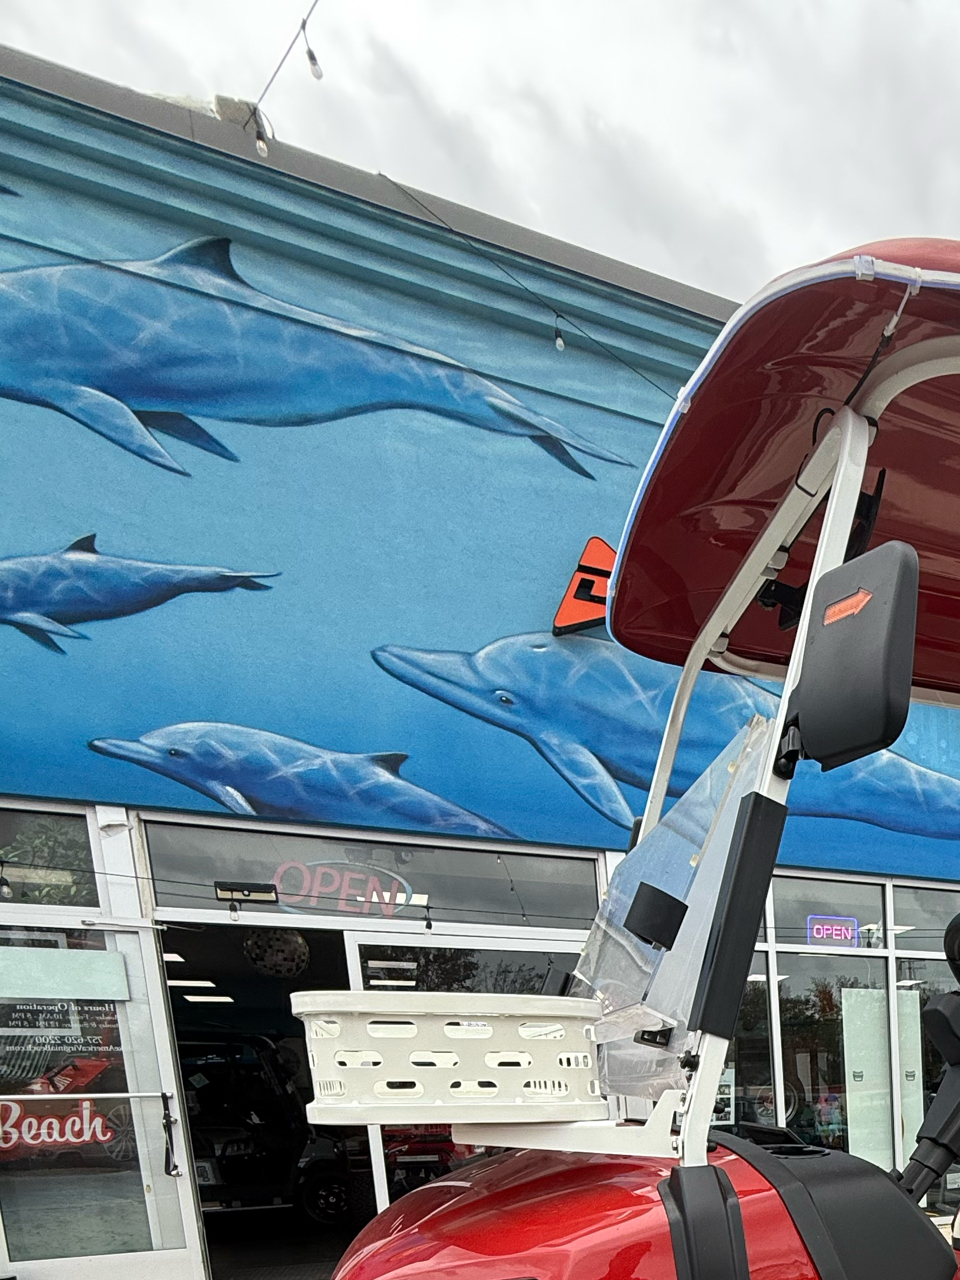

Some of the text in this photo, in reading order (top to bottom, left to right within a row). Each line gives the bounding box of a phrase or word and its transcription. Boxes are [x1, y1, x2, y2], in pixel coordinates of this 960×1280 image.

[273, 861, 399, 917] OPEN
[813, 924, 852, 940] OPEN
[0, 1101, 112, 1148] Beach
